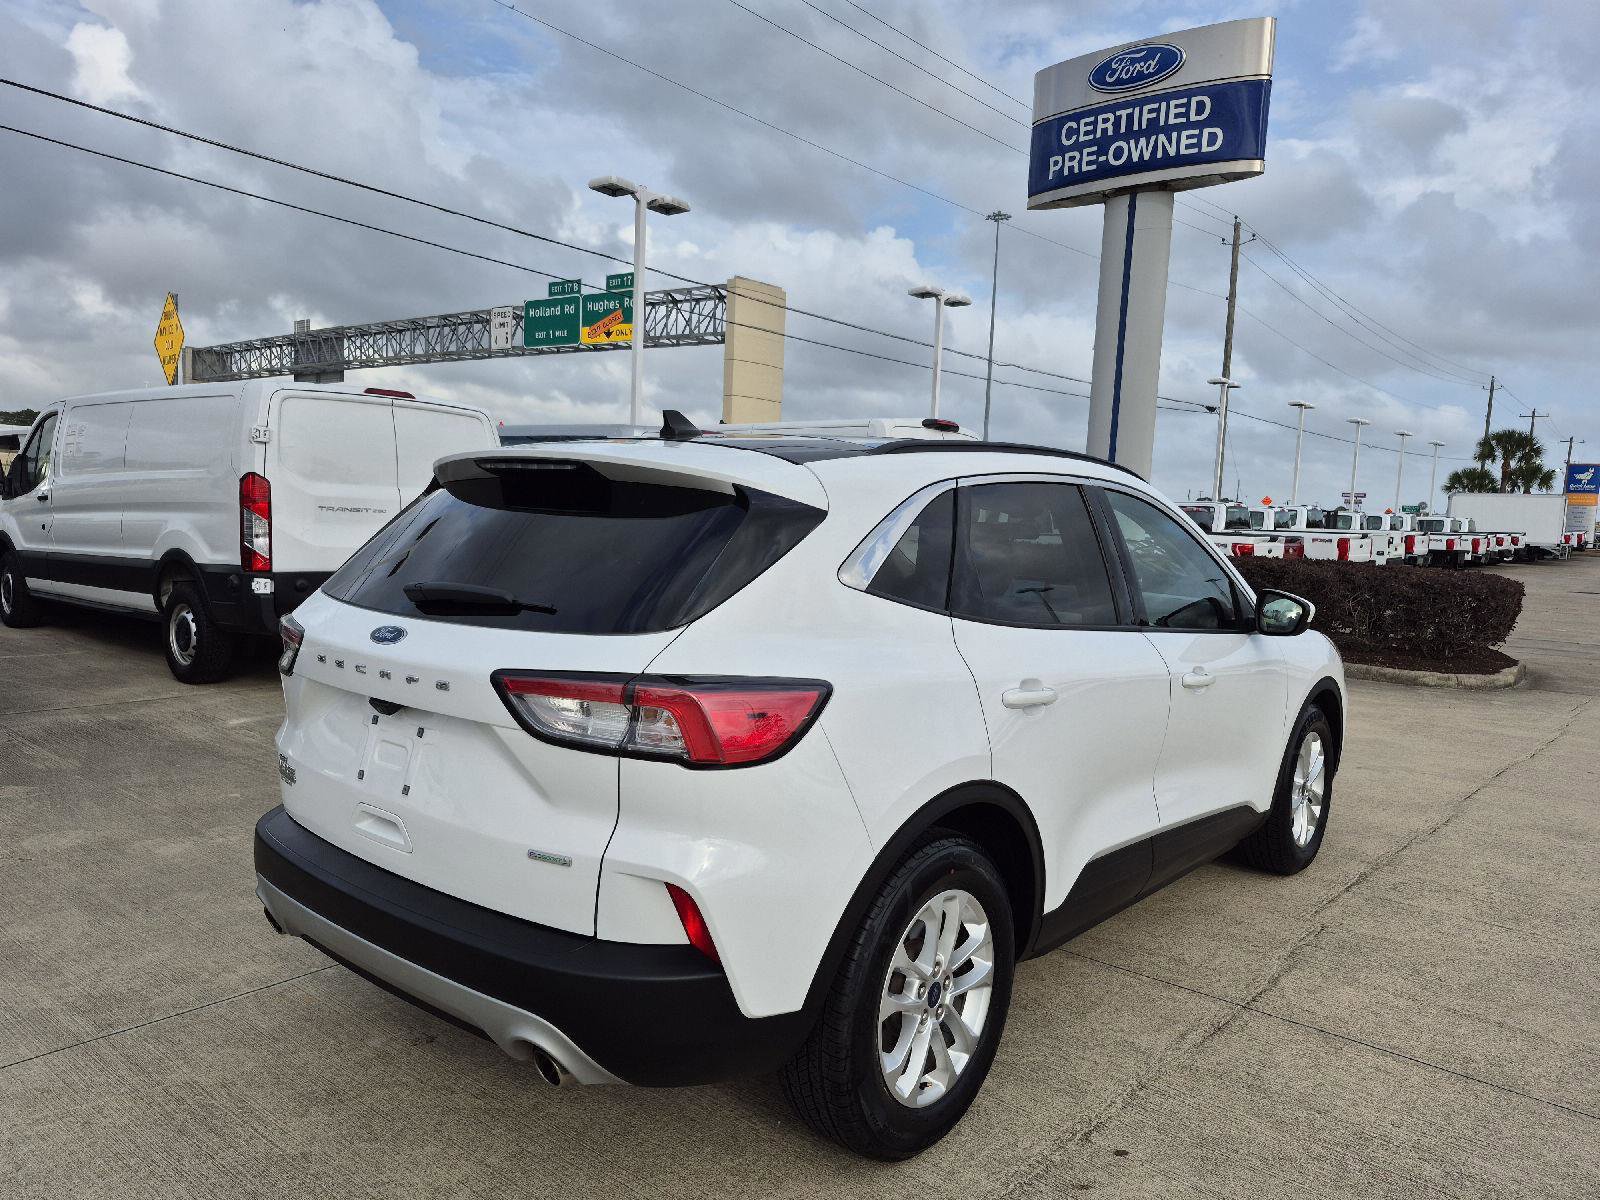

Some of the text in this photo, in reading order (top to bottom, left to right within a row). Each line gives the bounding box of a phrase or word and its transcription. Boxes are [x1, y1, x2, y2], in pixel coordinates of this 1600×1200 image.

[1105, 50, 1160, 82] Ford
[1060, 95, 1212, 146] CERTIFIED
[1048, 126, 1224, 180] PRE-OWNED
[610, 278, 621, 287] EXIT
[551, 285, 562, 293] EXIT
[529, 303, 575, 318] Holland Rd
[587, 299, 620, 313] Hughes
[493, 310, 512, 319] SPEED
[494, 321, 509, 330] LIMIT
[535, 331, 547, 339] EXIT
[555, 329, 568, 337] MILE
[317, 505, 372, 513] TRANSIT
